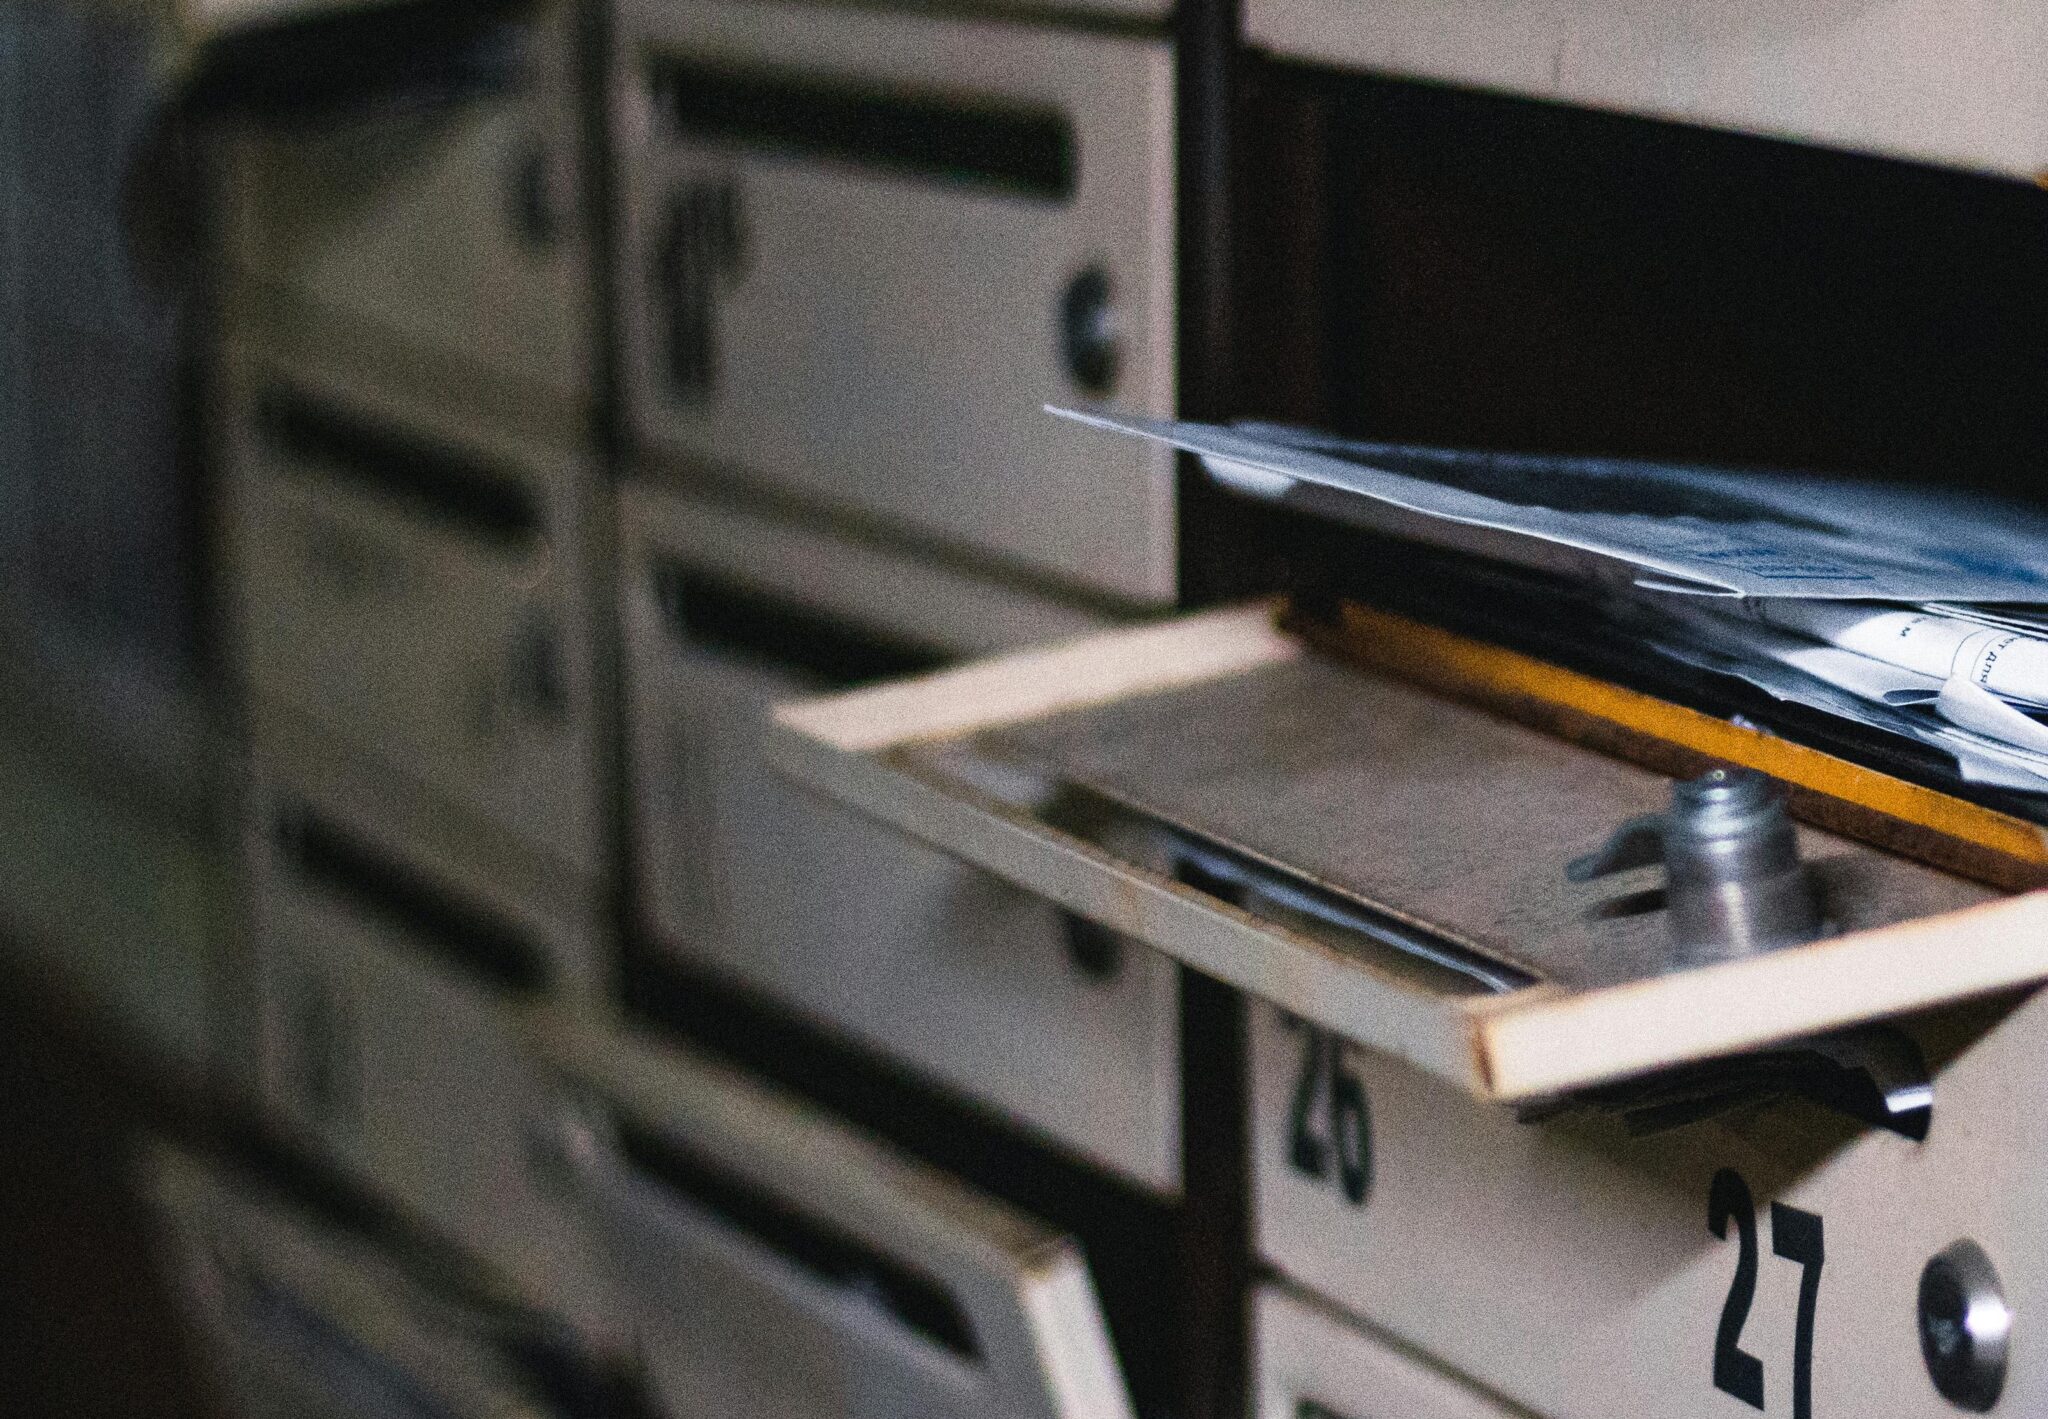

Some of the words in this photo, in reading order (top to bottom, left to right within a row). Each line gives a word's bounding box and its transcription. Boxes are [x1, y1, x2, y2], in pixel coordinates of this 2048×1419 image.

[1980, 651, 1998, 684] для
[1284, 1012, 1373, 1204] 26
[1707, 1167, 1825, 1419] 27
